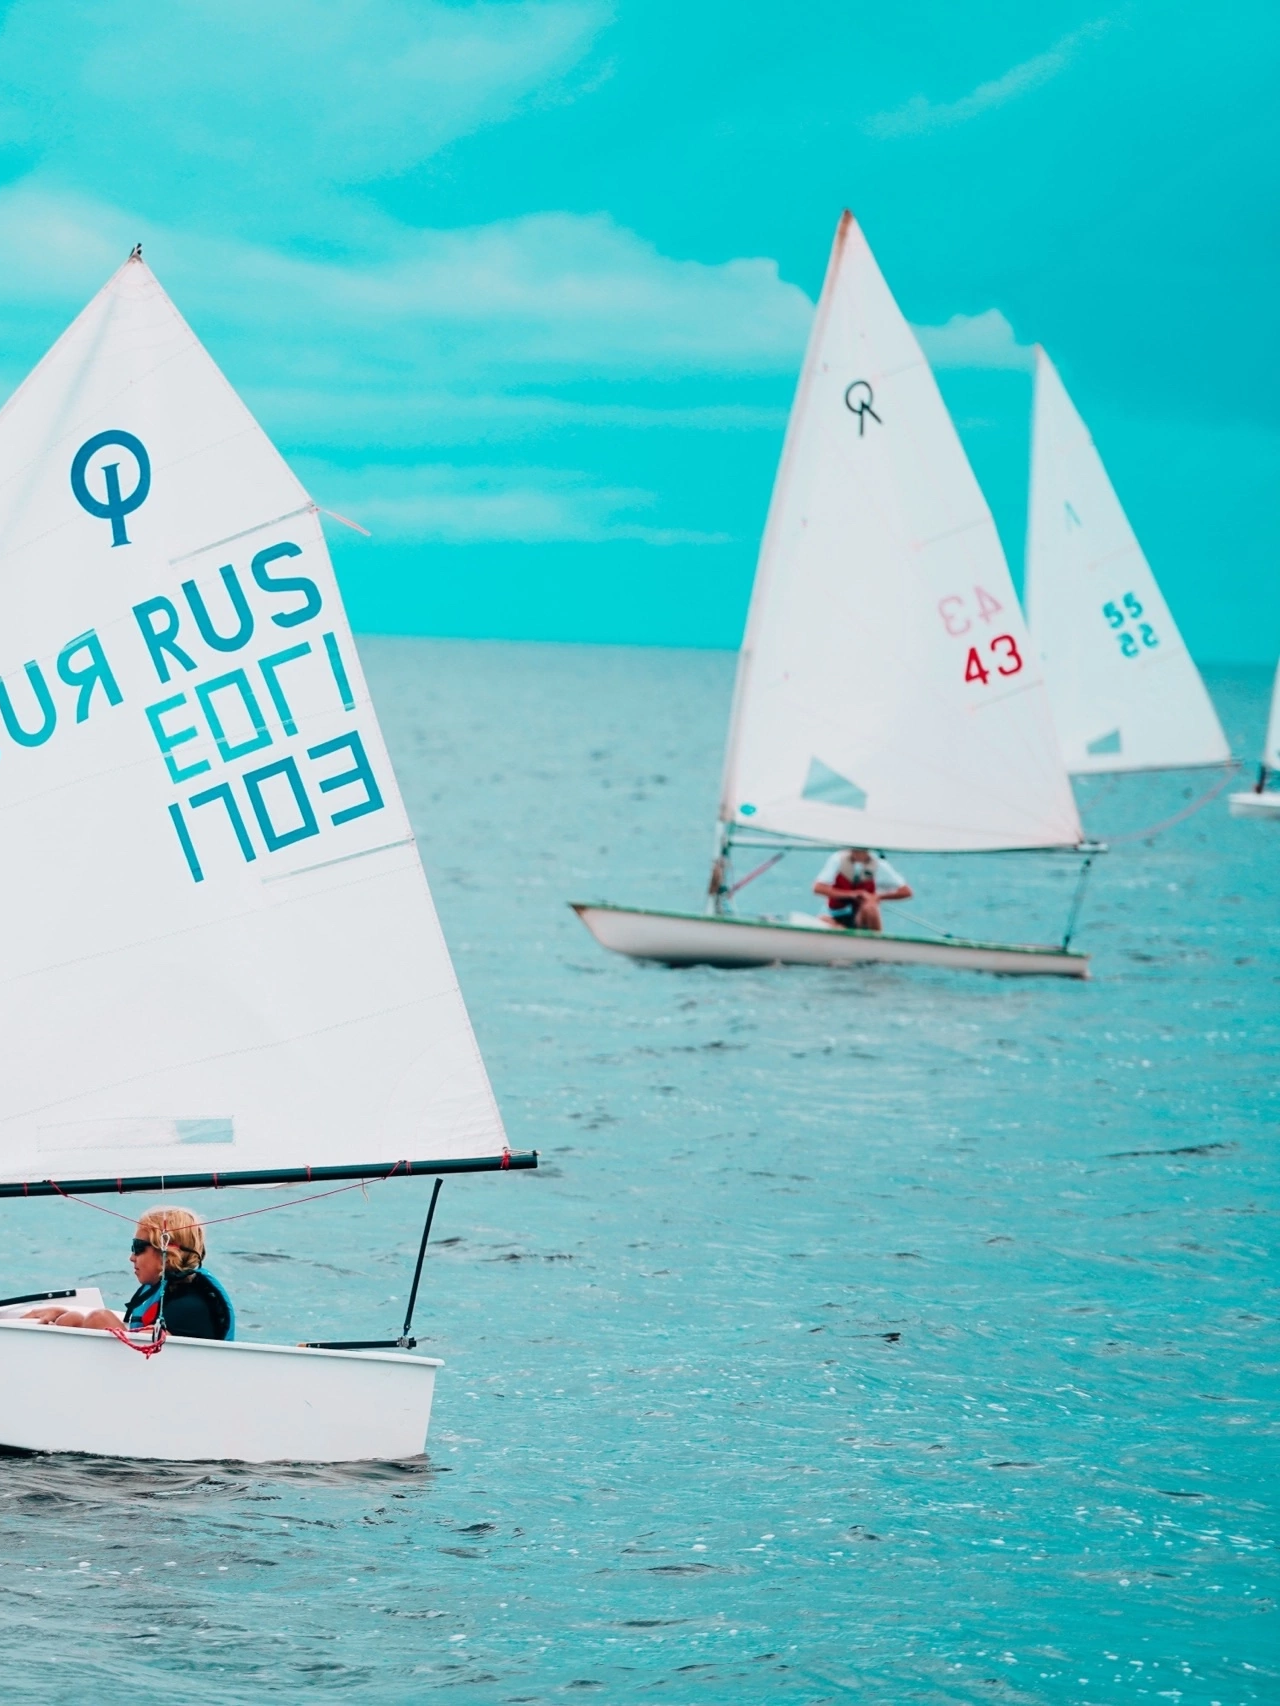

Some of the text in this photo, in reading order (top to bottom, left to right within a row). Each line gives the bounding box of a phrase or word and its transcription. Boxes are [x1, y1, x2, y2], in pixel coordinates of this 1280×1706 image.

[132, 541, 323, 684] RUS
[1102, 591, 1144, 629] 55
[964, 634, 1023, 685] 43
[168, 730, 385, 883] 1703
